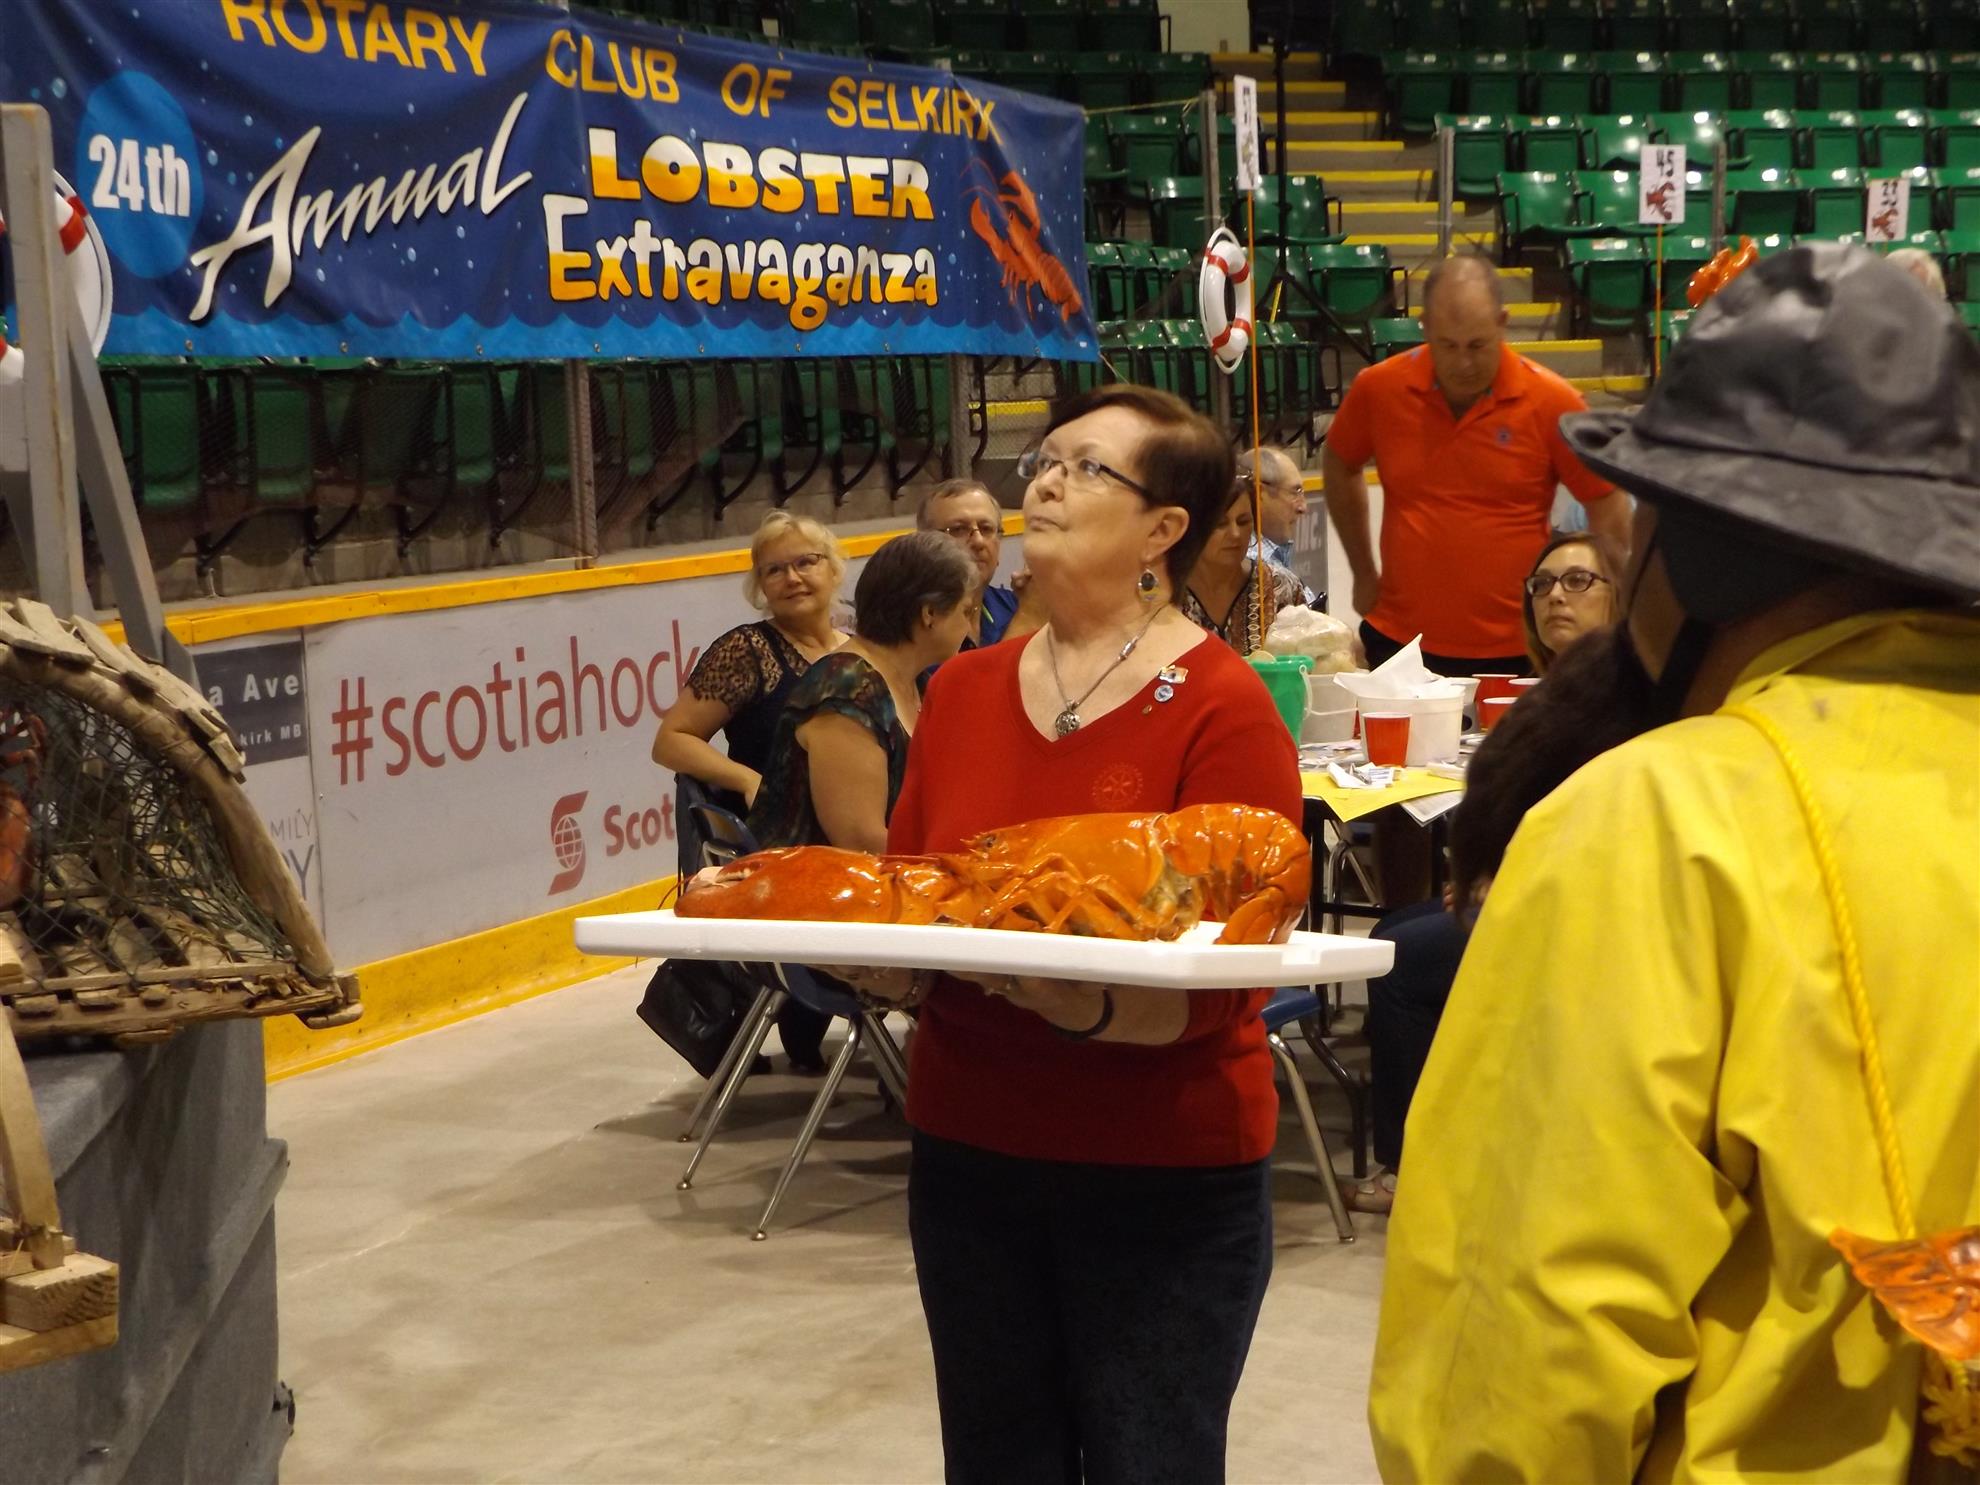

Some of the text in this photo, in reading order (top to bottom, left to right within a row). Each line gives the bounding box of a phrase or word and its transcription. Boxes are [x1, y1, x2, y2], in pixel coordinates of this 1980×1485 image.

[220, 0, 1003, 146] ROTARY CLUB OF SELKIRK
[88, 133, 191, 218] 24th
[587, 126, 935, 220] LOBSTER
[1656, 150, 1674, 177] 45
[188, 92, 534, 322] Annual
[542, 193, 938, 332] Extravaganza
[242, 673, 300, 702] Ave
[330, 619, 701, 786] #scotiahock
[240, 723, 302, 747] kirk MB
[269, 811, 313, 841] MILY
[603, 793, 676, 857] Scot
